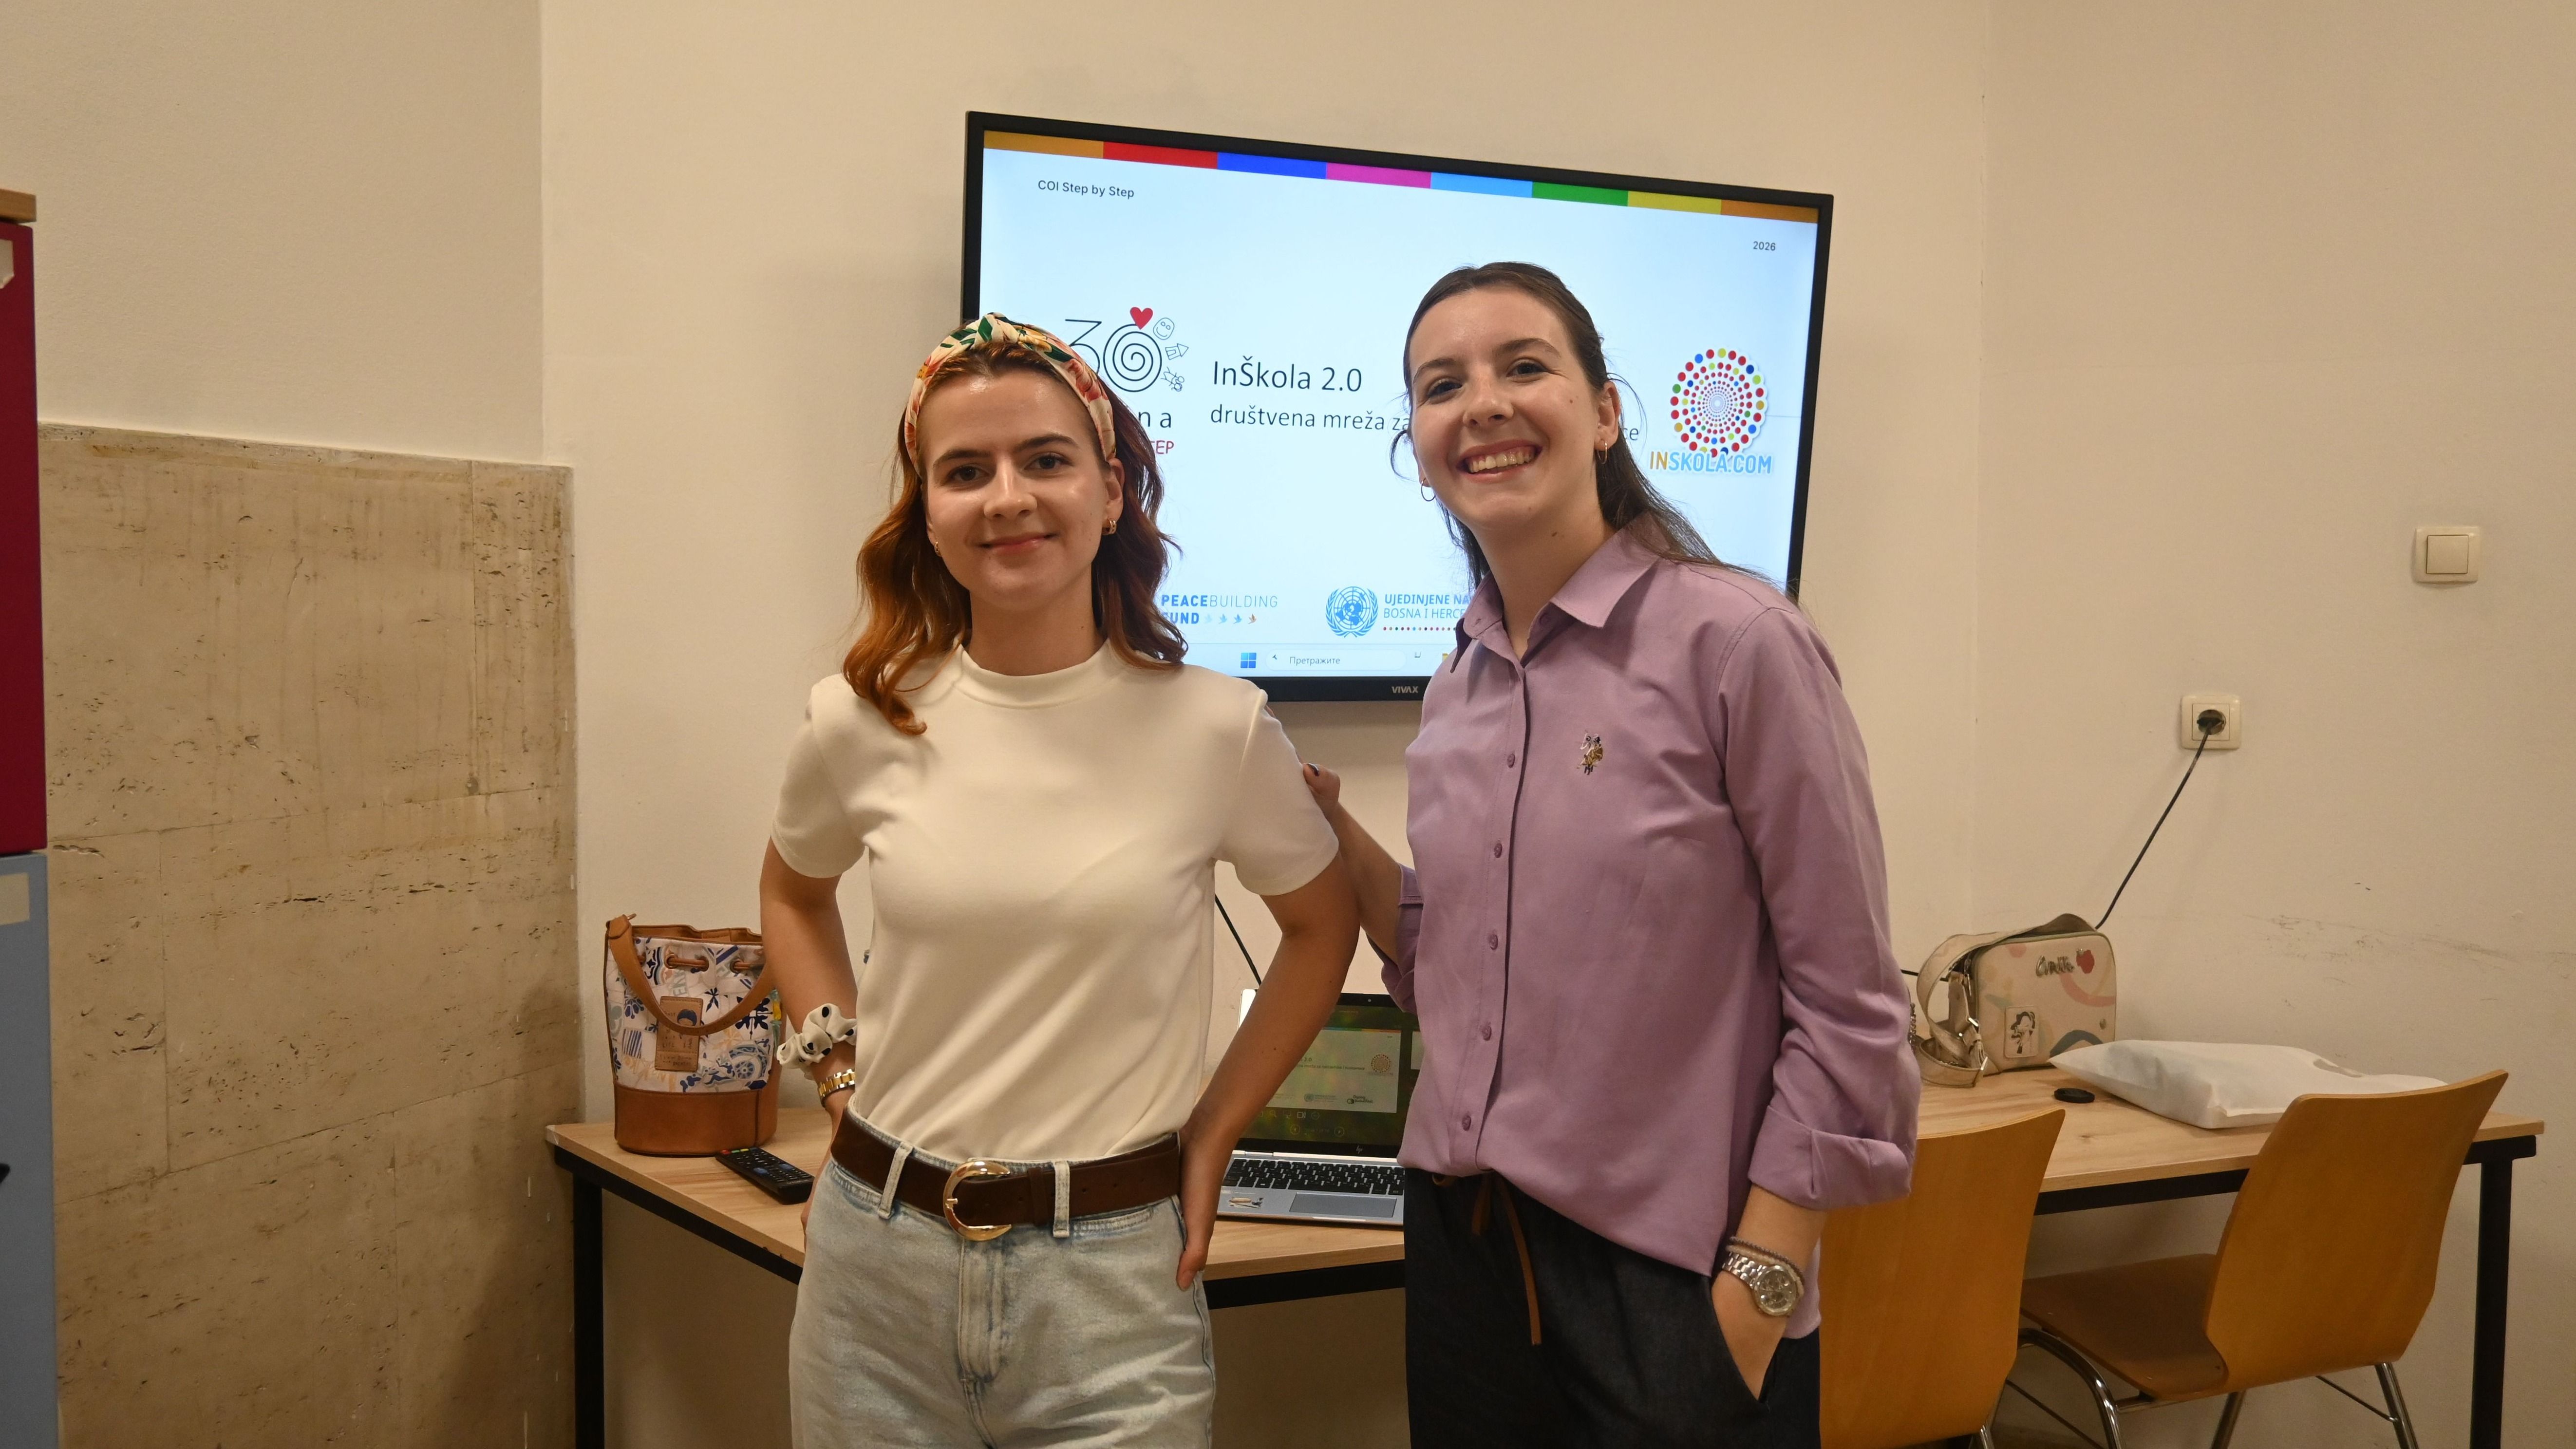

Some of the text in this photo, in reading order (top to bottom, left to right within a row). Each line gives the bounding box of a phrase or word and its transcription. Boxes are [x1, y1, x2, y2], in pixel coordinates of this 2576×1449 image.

[1038, 180, 1134, 199] COI Step by Step
[1753, 241, 1776, 251] 2026
[1213, 356, 1362, 392] InŠkola 2.0
[1210, 404, 1315, 428] društvena
[1323, 410, 1384, 430] mreža
[1650, 451, 1772, 474] INSKOLA.COM
[1161, 595, 1278, 607] PEACEBUILDING
[1385, 594, 1450, 606] UJEDINJENE
[1384, 608, 1421, 619] BOSNA
[1425, 608, 1429, 619] I
[1290, 656, 1340, 666] Претражите
